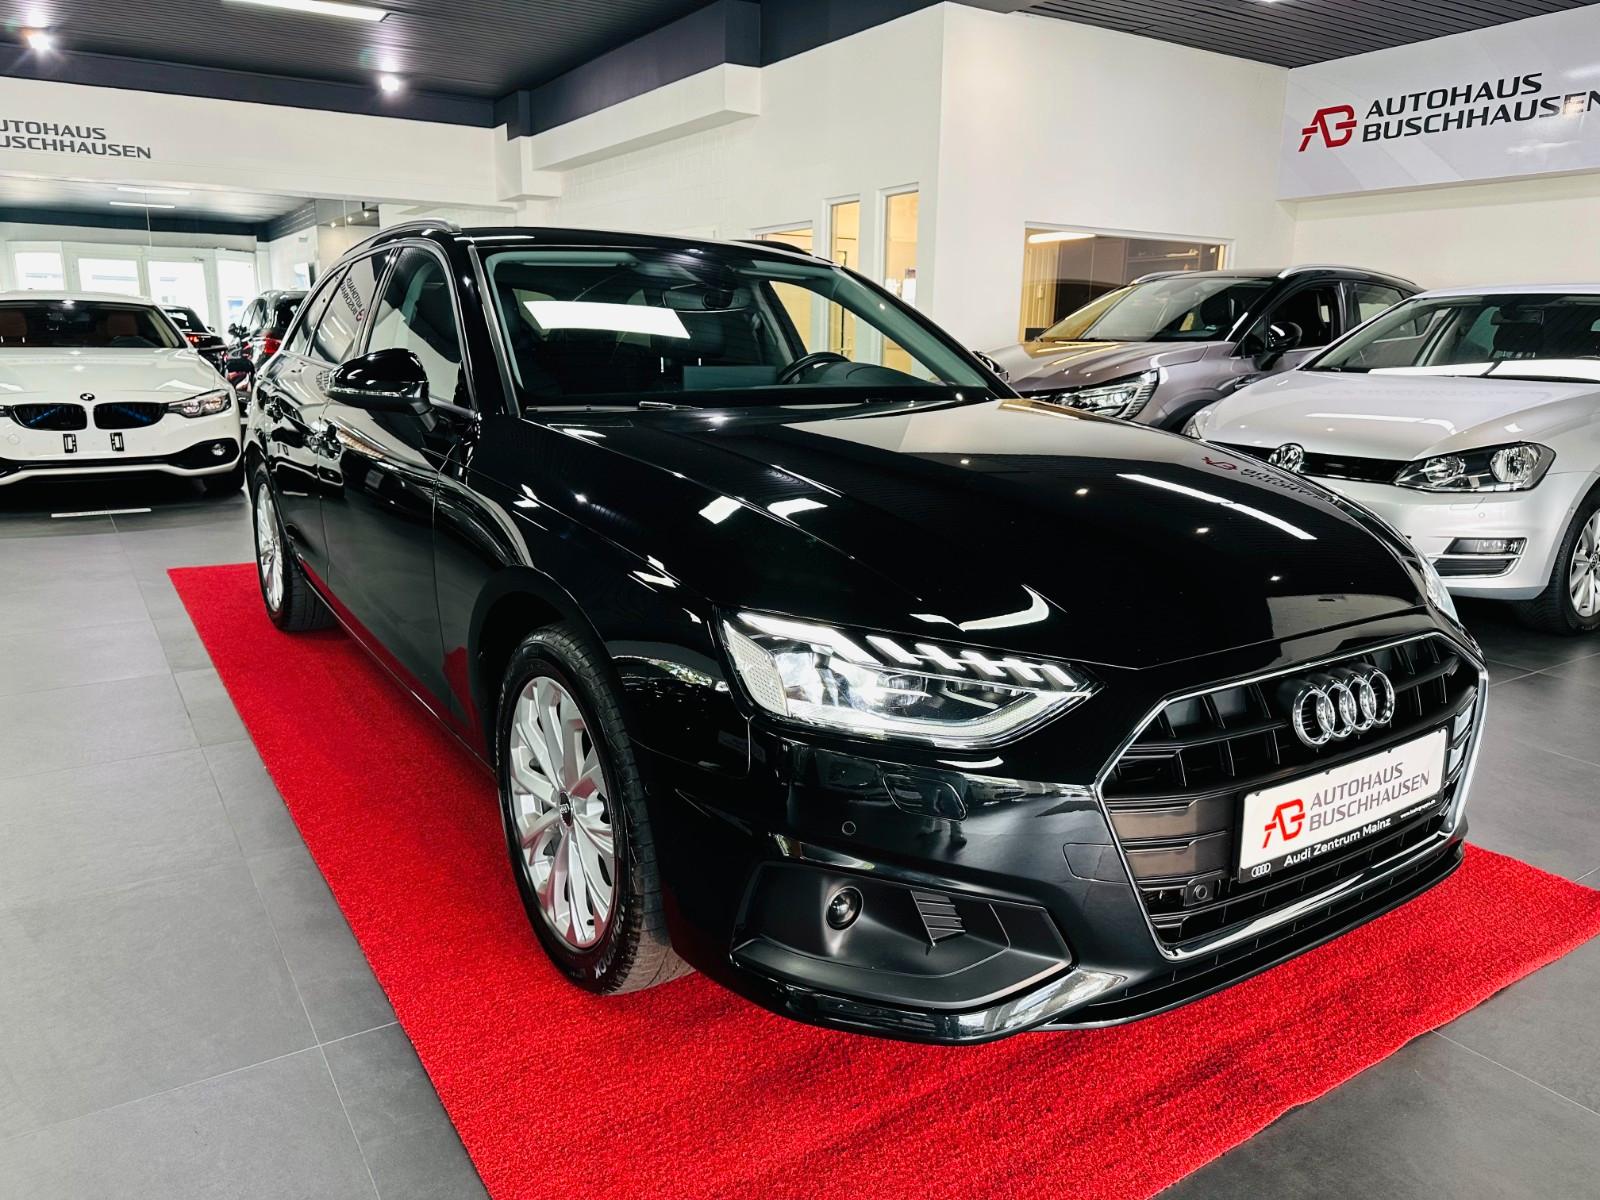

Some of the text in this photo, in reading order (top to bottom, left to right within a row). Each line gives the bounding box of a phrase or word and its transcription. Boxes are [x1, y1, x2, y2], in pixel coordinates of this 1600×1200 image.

[1365, 73, 1542, 119] AUTOHAUS
[1309, 769, 1430, 832] BUSCHHAUSEN
[1310, 762, 1404, 810] AUTOHAUS
[1283, 818, 1392, 867] Audi Zentrum Mainz
